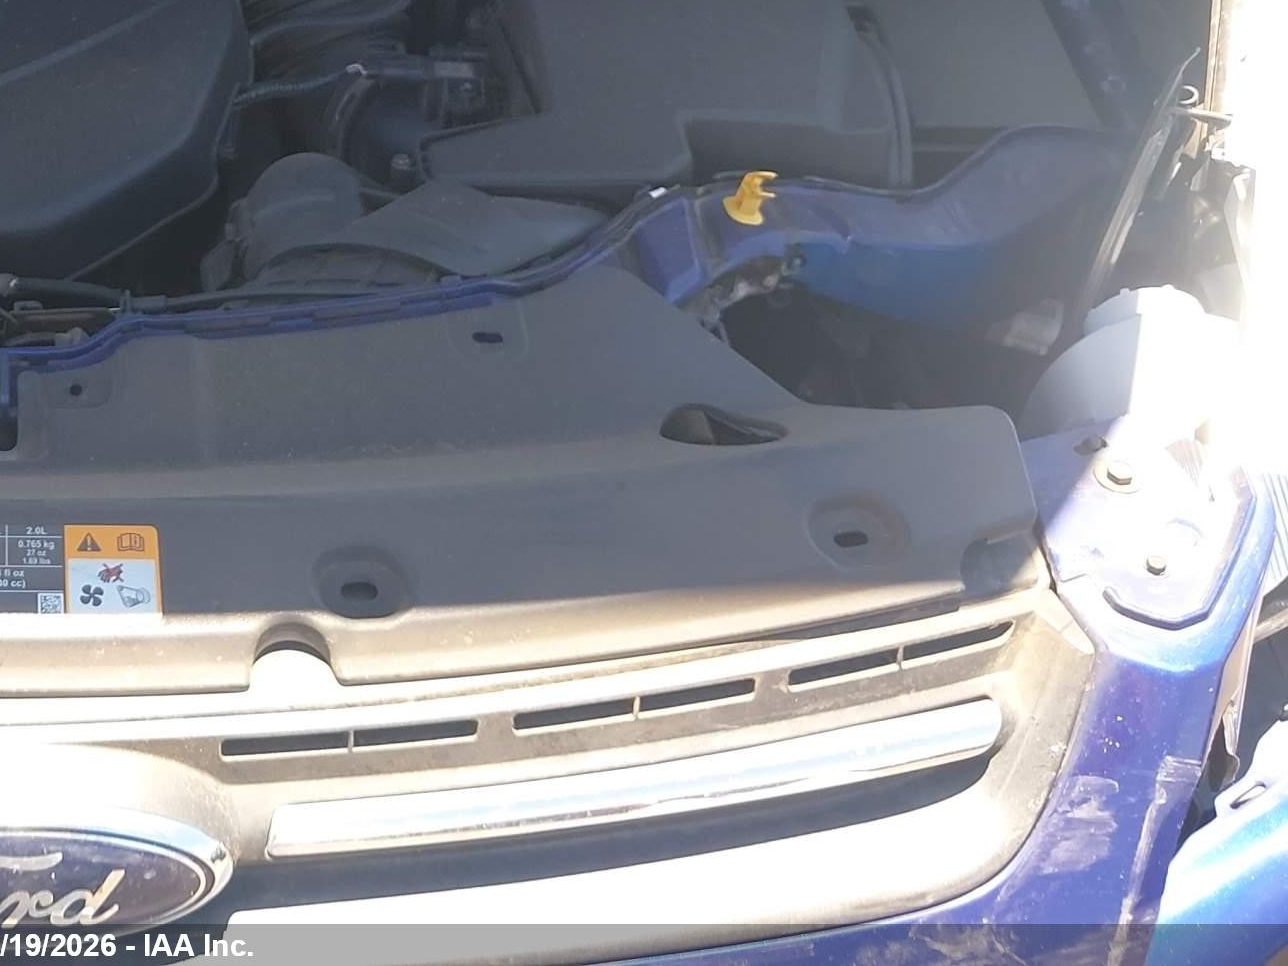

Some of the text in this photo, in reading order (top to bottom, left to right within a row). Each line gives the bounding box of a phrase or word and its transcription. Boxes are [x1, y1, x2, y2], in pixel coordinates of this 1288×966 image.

[25, 526, 48, 535] 2.0L
[17, 539, 55, 550] 0.765 kg
[3, 568, 11, 577] fl
[10, 579, 26, 589] cc)
